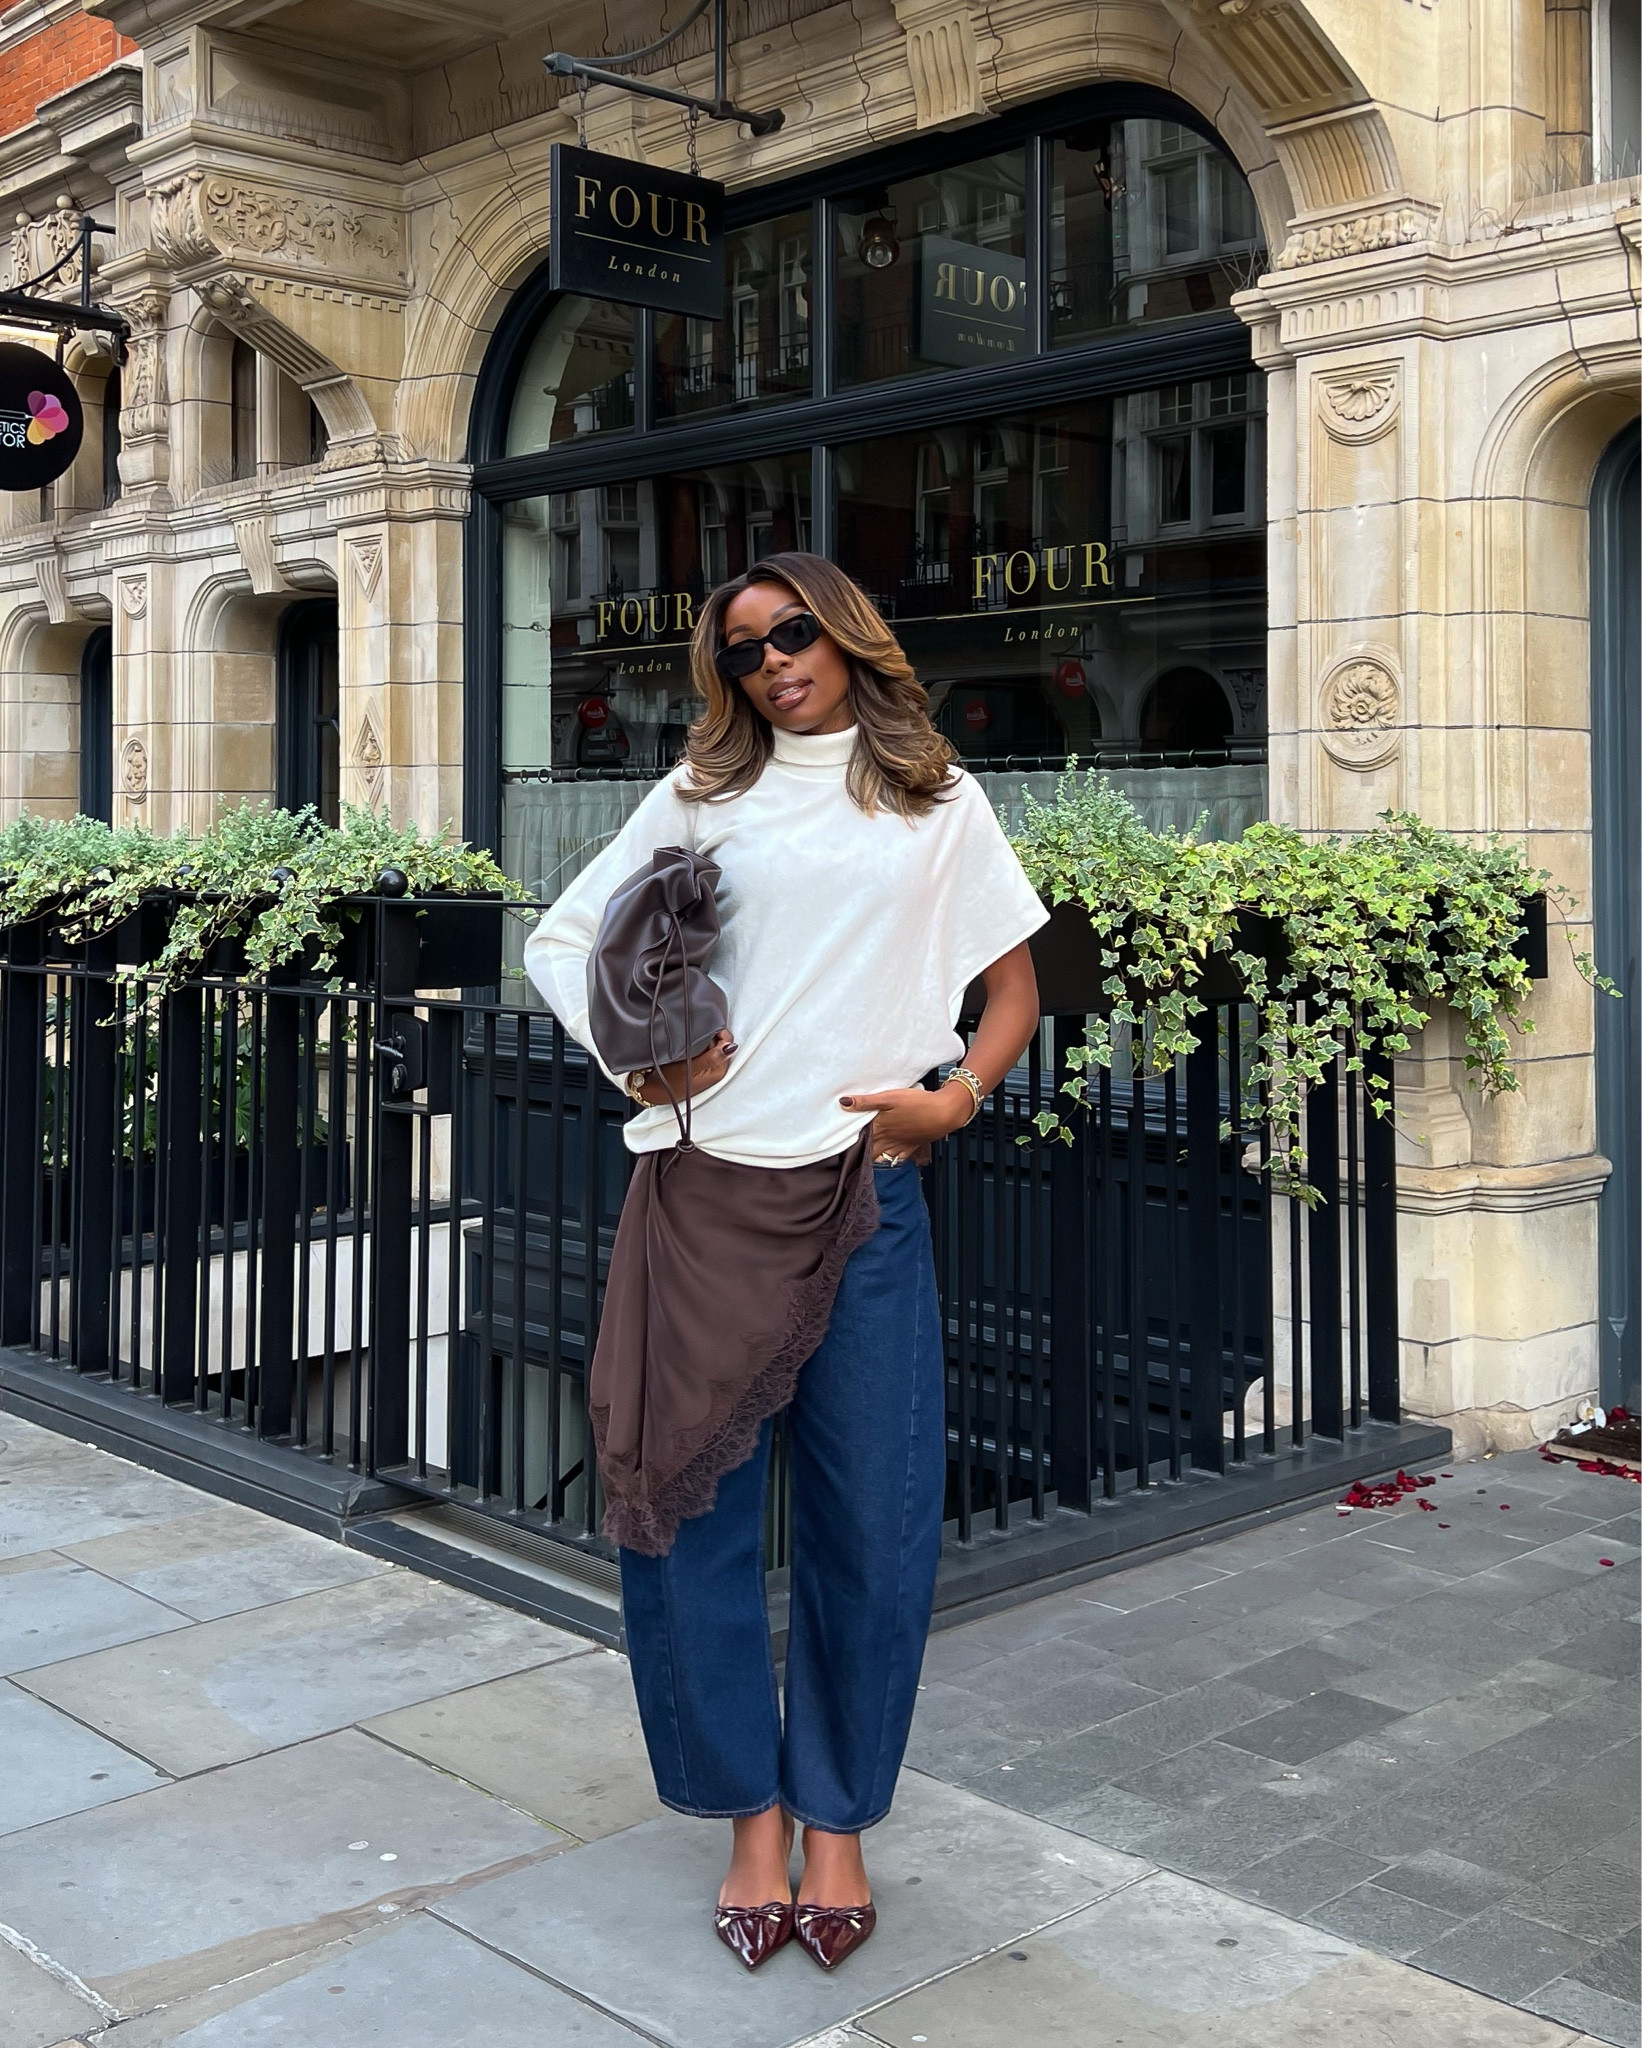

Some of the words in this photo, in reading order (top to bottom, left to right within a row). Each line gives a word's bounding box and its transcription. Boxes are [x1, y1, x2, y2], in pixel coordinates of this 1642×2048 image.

[574, 174, 711, 246] FOUR
[608, 255, 681, 283] London
[971, 541, 1115, 599] FOUR
[596, 592, 697, 638] FOUR
[1003, 623, 1080, 642] London
[618, 659, 673, 675] London
